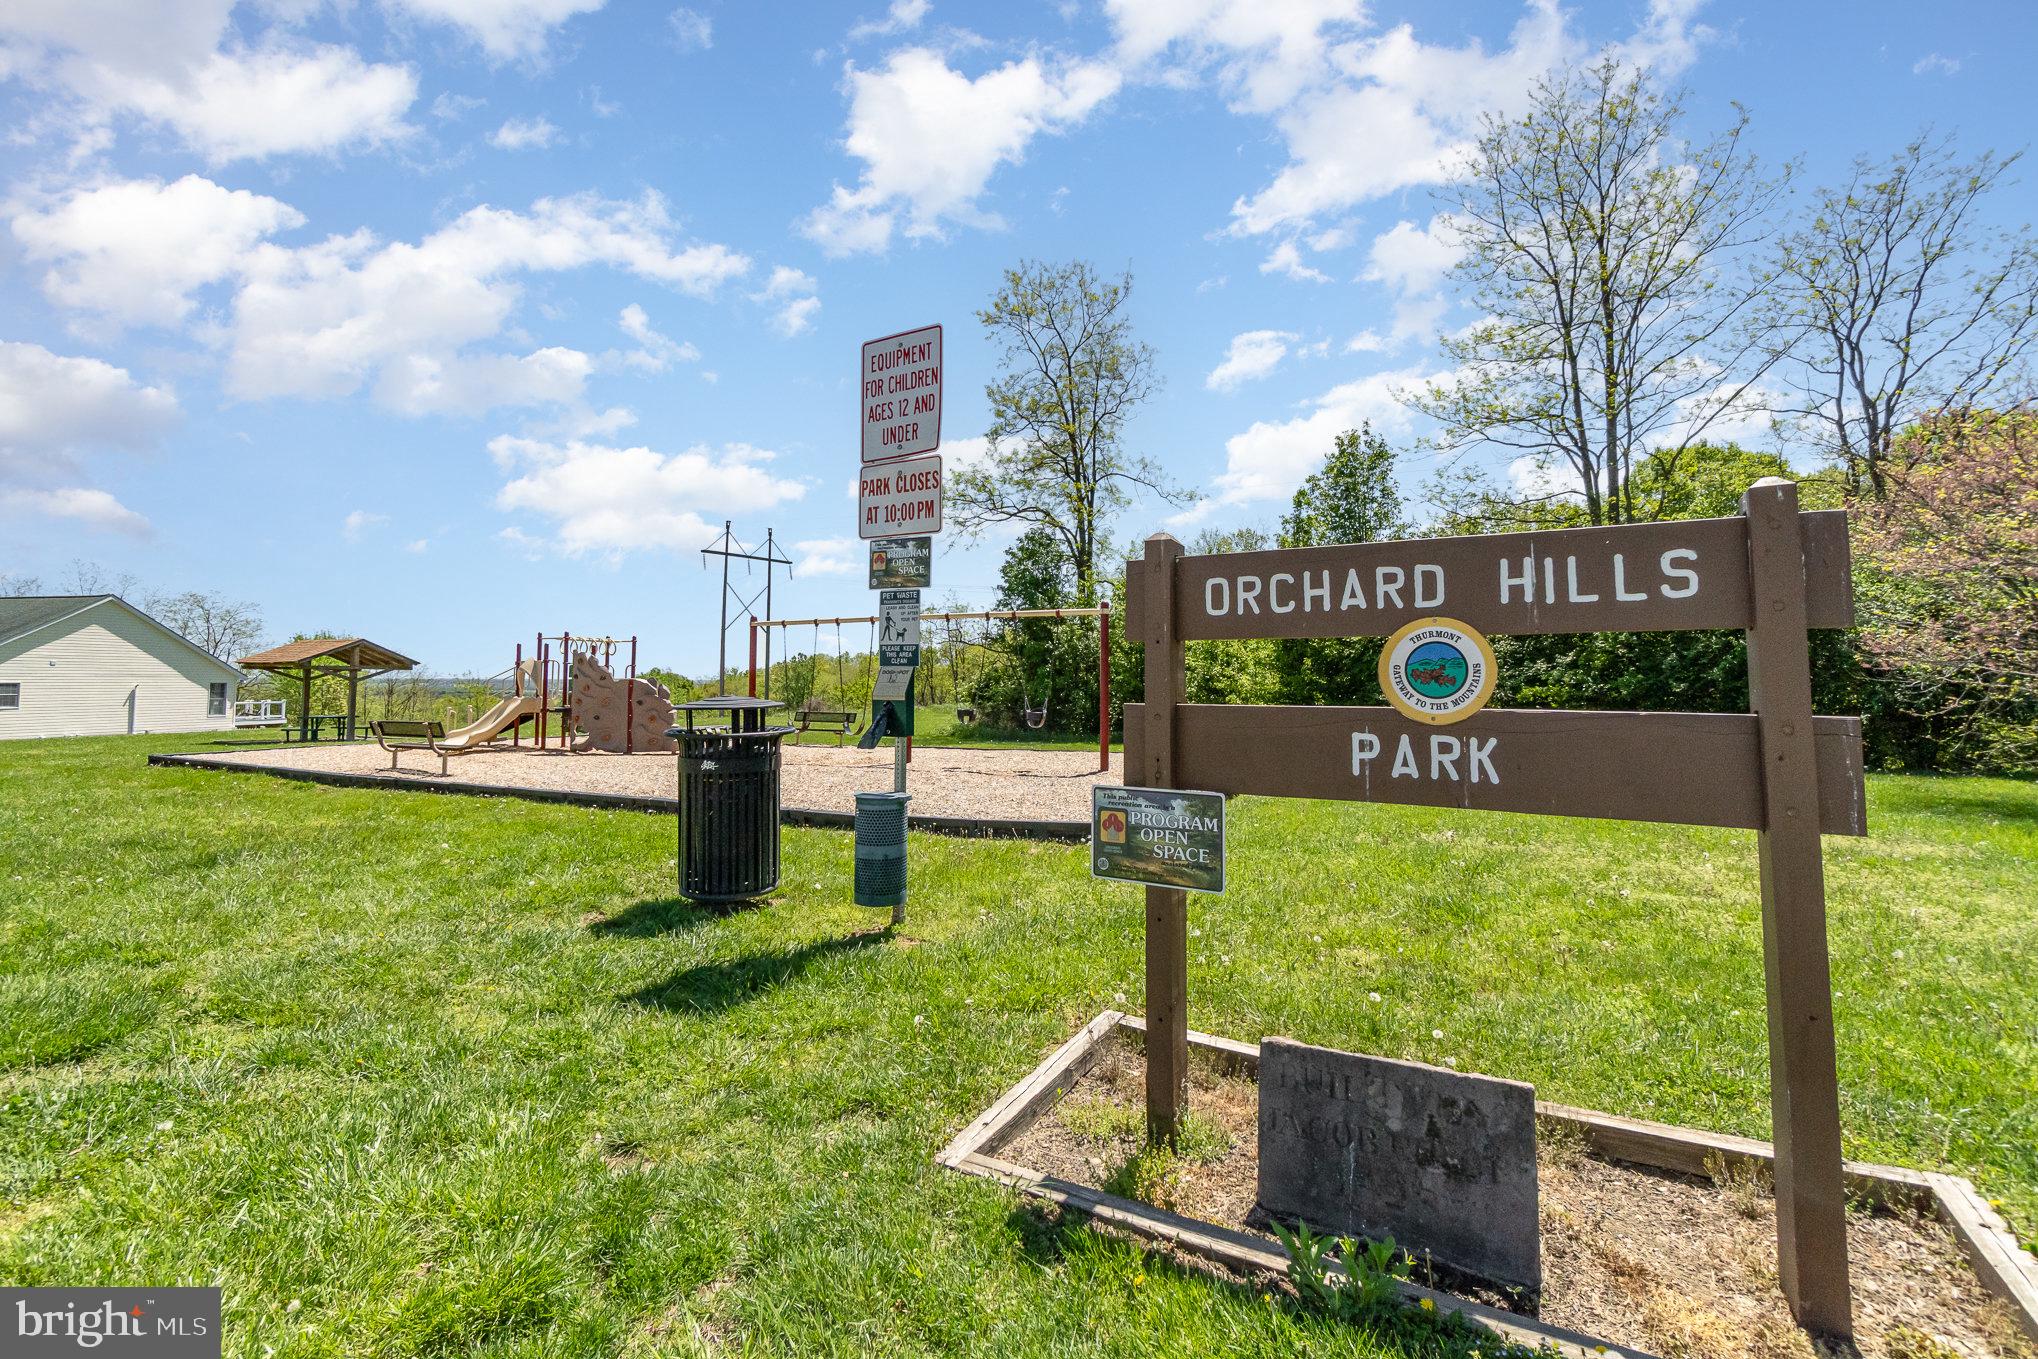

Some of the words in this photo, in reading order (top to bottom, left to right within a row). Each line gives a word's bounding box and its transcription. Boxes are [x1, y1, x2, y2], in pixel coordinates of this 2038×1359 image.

[871, 342, 933, 373] EQUIPMENT
[865, 378, 884, 399] FOR
[888, 366, 939, 394] CHILDREN
[867, 401, 894, 423] AGES
[898, 398, 908, 418] 12
[913, 393, 935, 416] AND
[882, 422, 919, 445] UNDER
[861, 476, 891, 498] PARK
[896, 470, 940, 494] CLOSES
[866, 505, 880, 524] AT
[884, 502, 915, 523] 10:00
[917, 499, 935, 519] PM
[888, 548, 929, 559] PROGRAM
[892, 558, 915, 566] OPEN
[898, 565, 925, 575] SPACE
[1205, 564, 1445, 616] ORCHARD
[1500, 548, 1699, 604] HILLS
[897, 591, 918, 599] WASTE
[1409, 630, 1461, 645] THURMONT
[1393, 664, 1415, 701] GATEWAY
[1415, 697, 1427, 708] TO
[1430, 702, 1449, 711] THE
[1451, 662, 1482, 708] MOUNTAINS
[1351, 731, 1500, 784] PARK
[1130, 811, 1219, 832] PROGRAM
[1140, 828, 1188, 845] OPEN
[1153, 844, 1210, 863] SPACE
